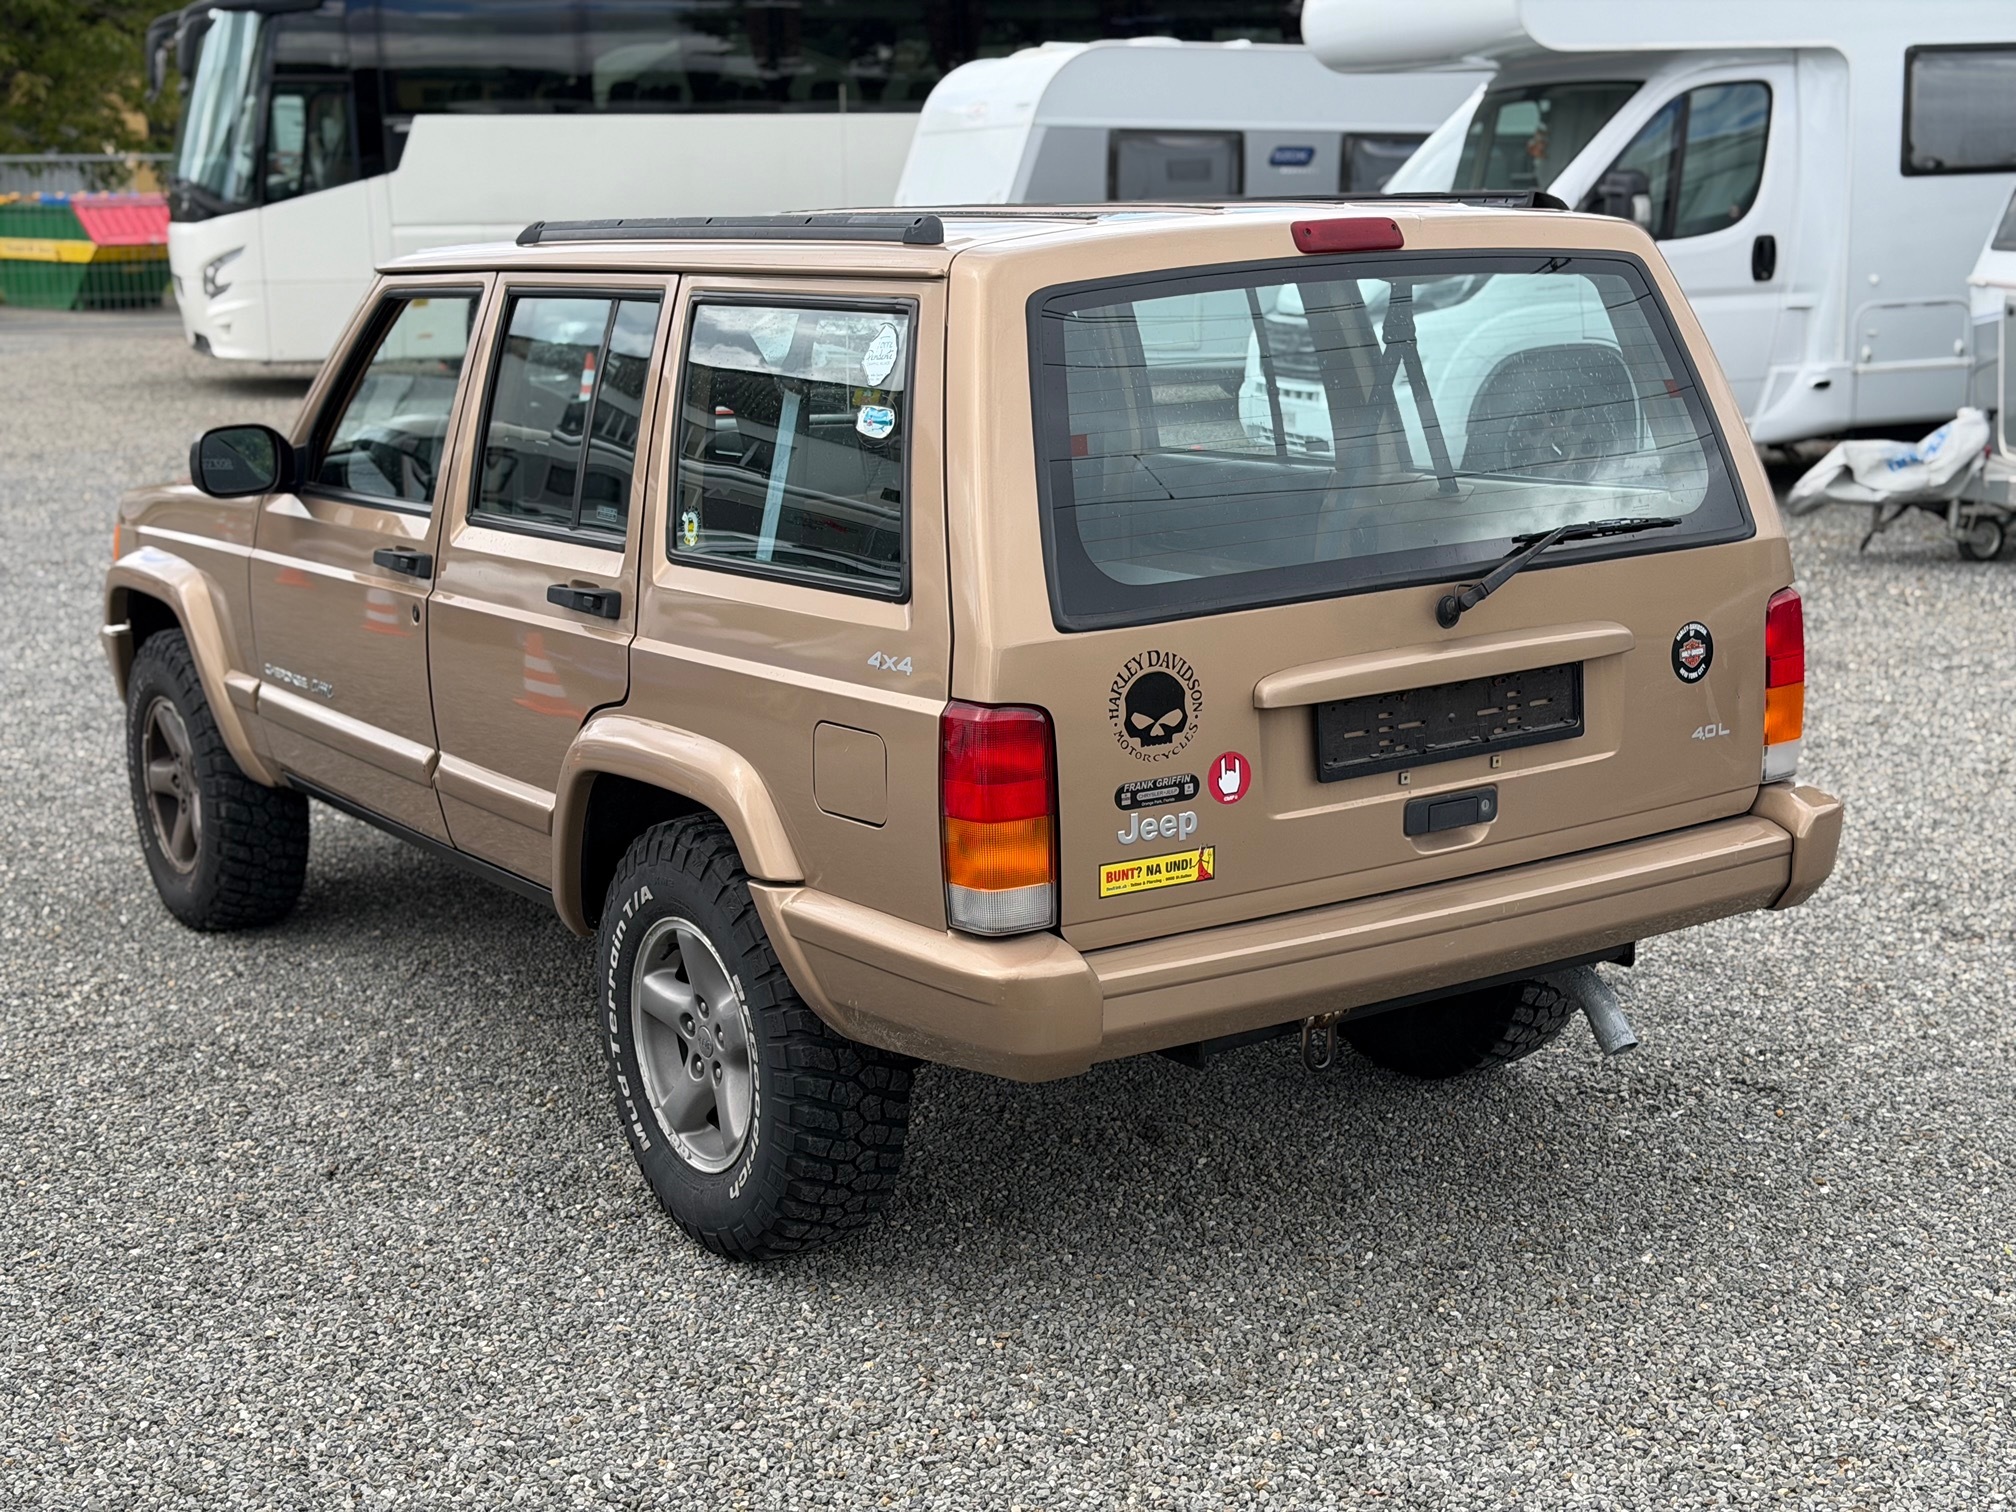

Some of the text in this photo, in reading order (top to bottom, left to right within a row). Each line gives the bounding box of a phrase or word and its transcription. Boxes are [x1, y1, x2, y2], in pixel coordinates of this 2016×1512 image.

[1108, 649, 1203, 720] HARLEY DAVIDSON
[1113, 722, 1199, 762] MOTORCYCLES
[1123, 773, 1191, 793] FRANK GRIFFIN
[1117, 810, 1198, 844] Jeep
[1105, 857, 1193, 884] BUNT? NA UND!
[608, 885, 654, 1152] Mud-Terrain T/A
[729, 974, 761, 1201] BFGoodrich
